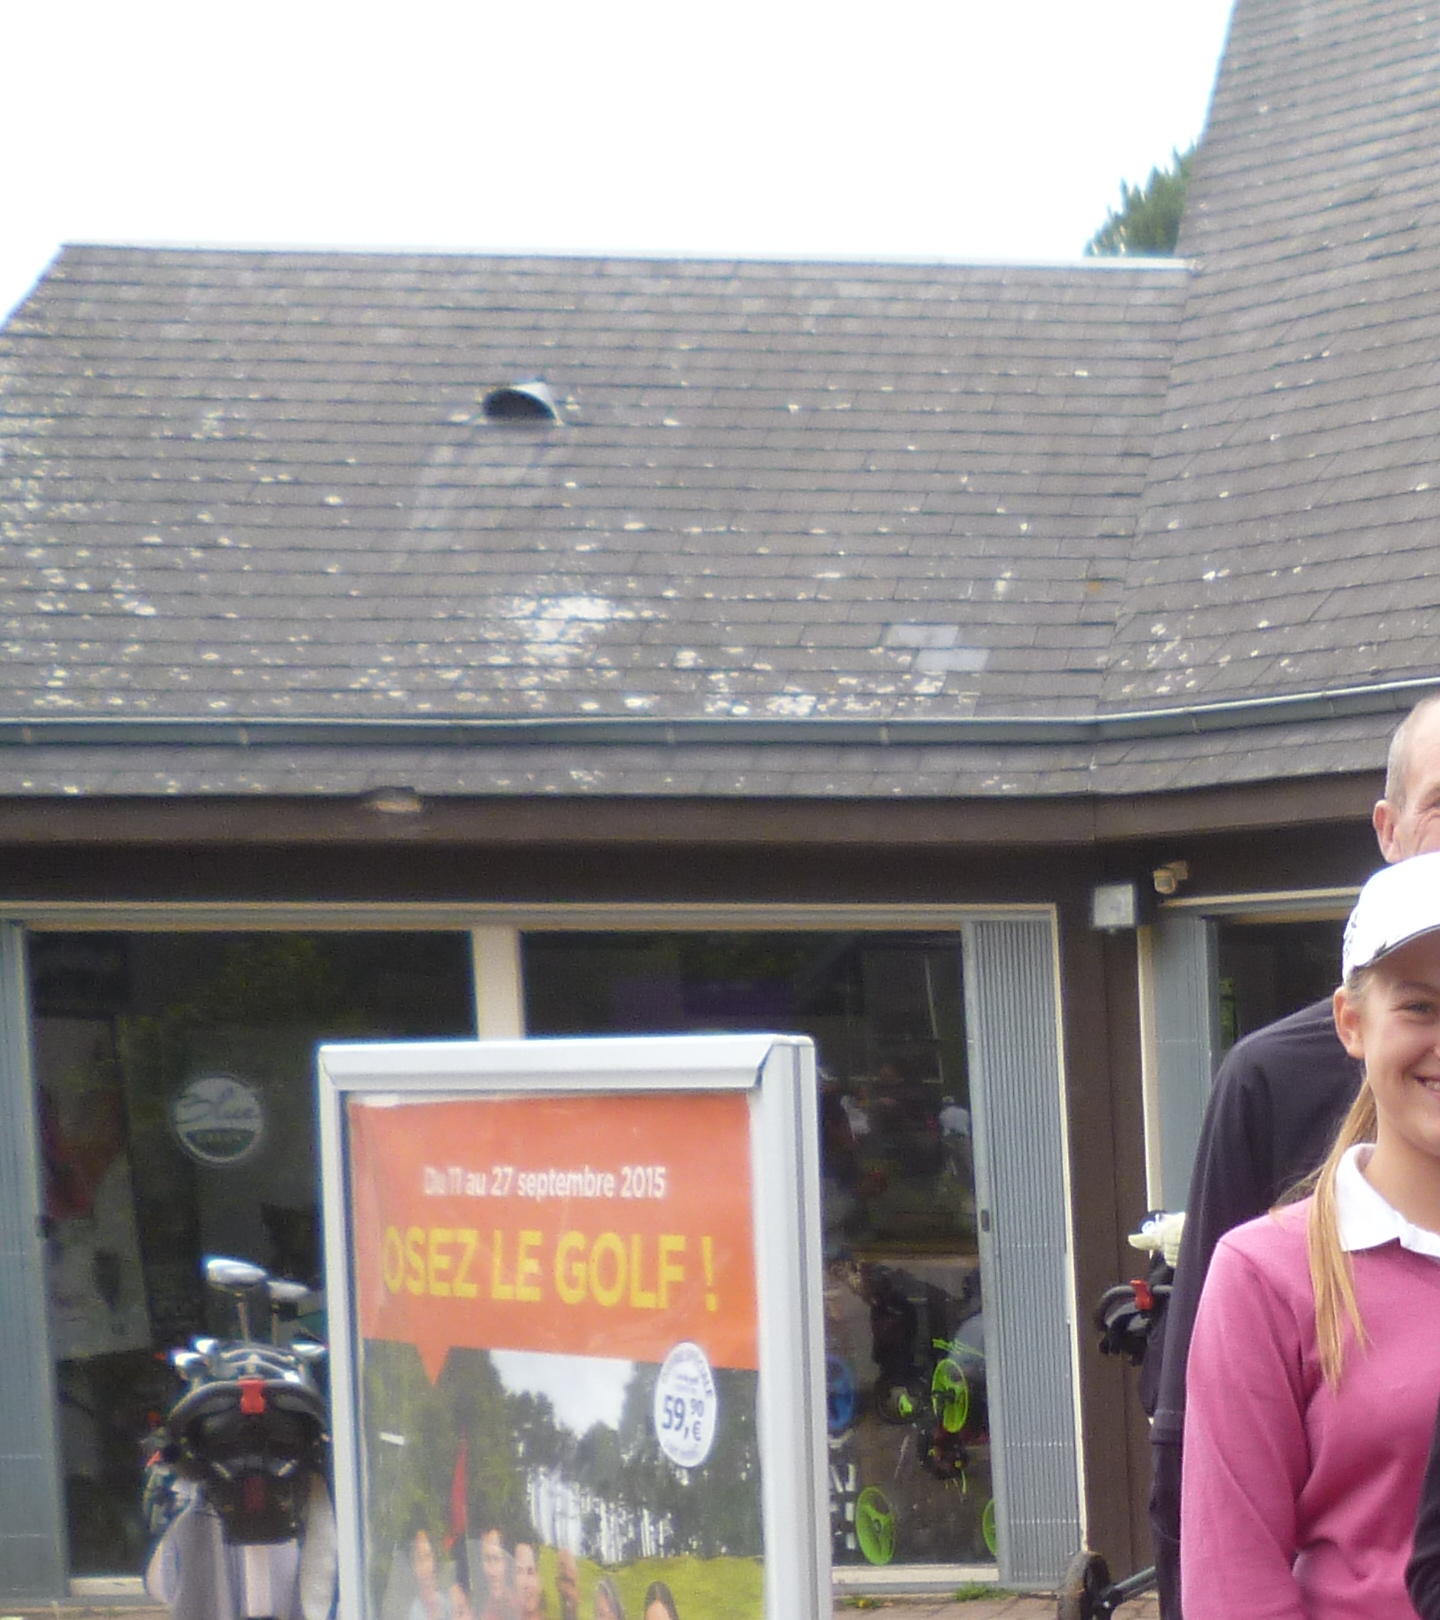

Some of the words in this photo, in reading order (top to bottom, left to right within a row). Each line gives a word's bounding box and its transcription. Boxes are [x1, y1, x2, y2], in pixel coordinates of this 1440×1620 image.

[467, 1171, 486, 1196] au
[491, 1166, 513, 1197] 27
[517, 1165, 615, 1202] septembre
[620, 1165, 666, 1199] 2015
[383, 1225, 479, 1298] OSEZ
[491, 1229, 542, 1301] LE
[555, 1230, 687, 1309] GOLF
[702, 1235, 718, 1311] !
